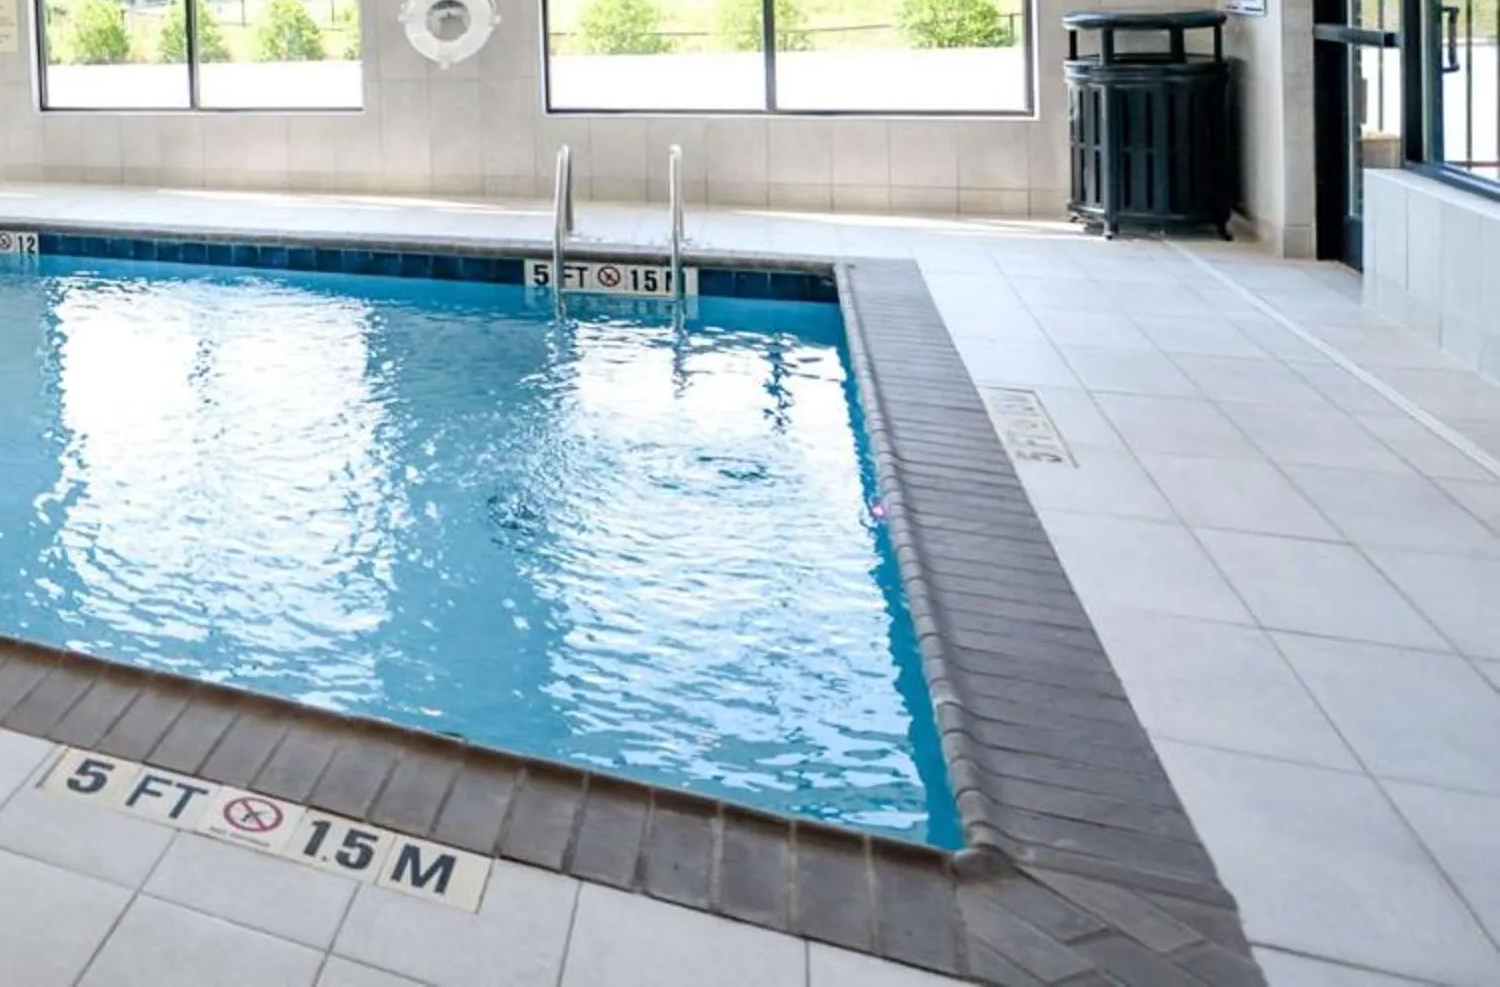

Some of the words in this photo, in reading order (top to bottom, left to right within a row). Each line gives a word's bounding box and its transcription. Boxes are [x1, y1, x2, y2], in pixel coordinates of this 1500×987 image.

[18, 235, 35, 254] 12
[533, 264, 549, 286] 5
[66, 759, 116, 794] 5
[125, 774, 209, 820] FT
[303, 820, 379, 870] 1.5
[390, 843, 457, 895] M
